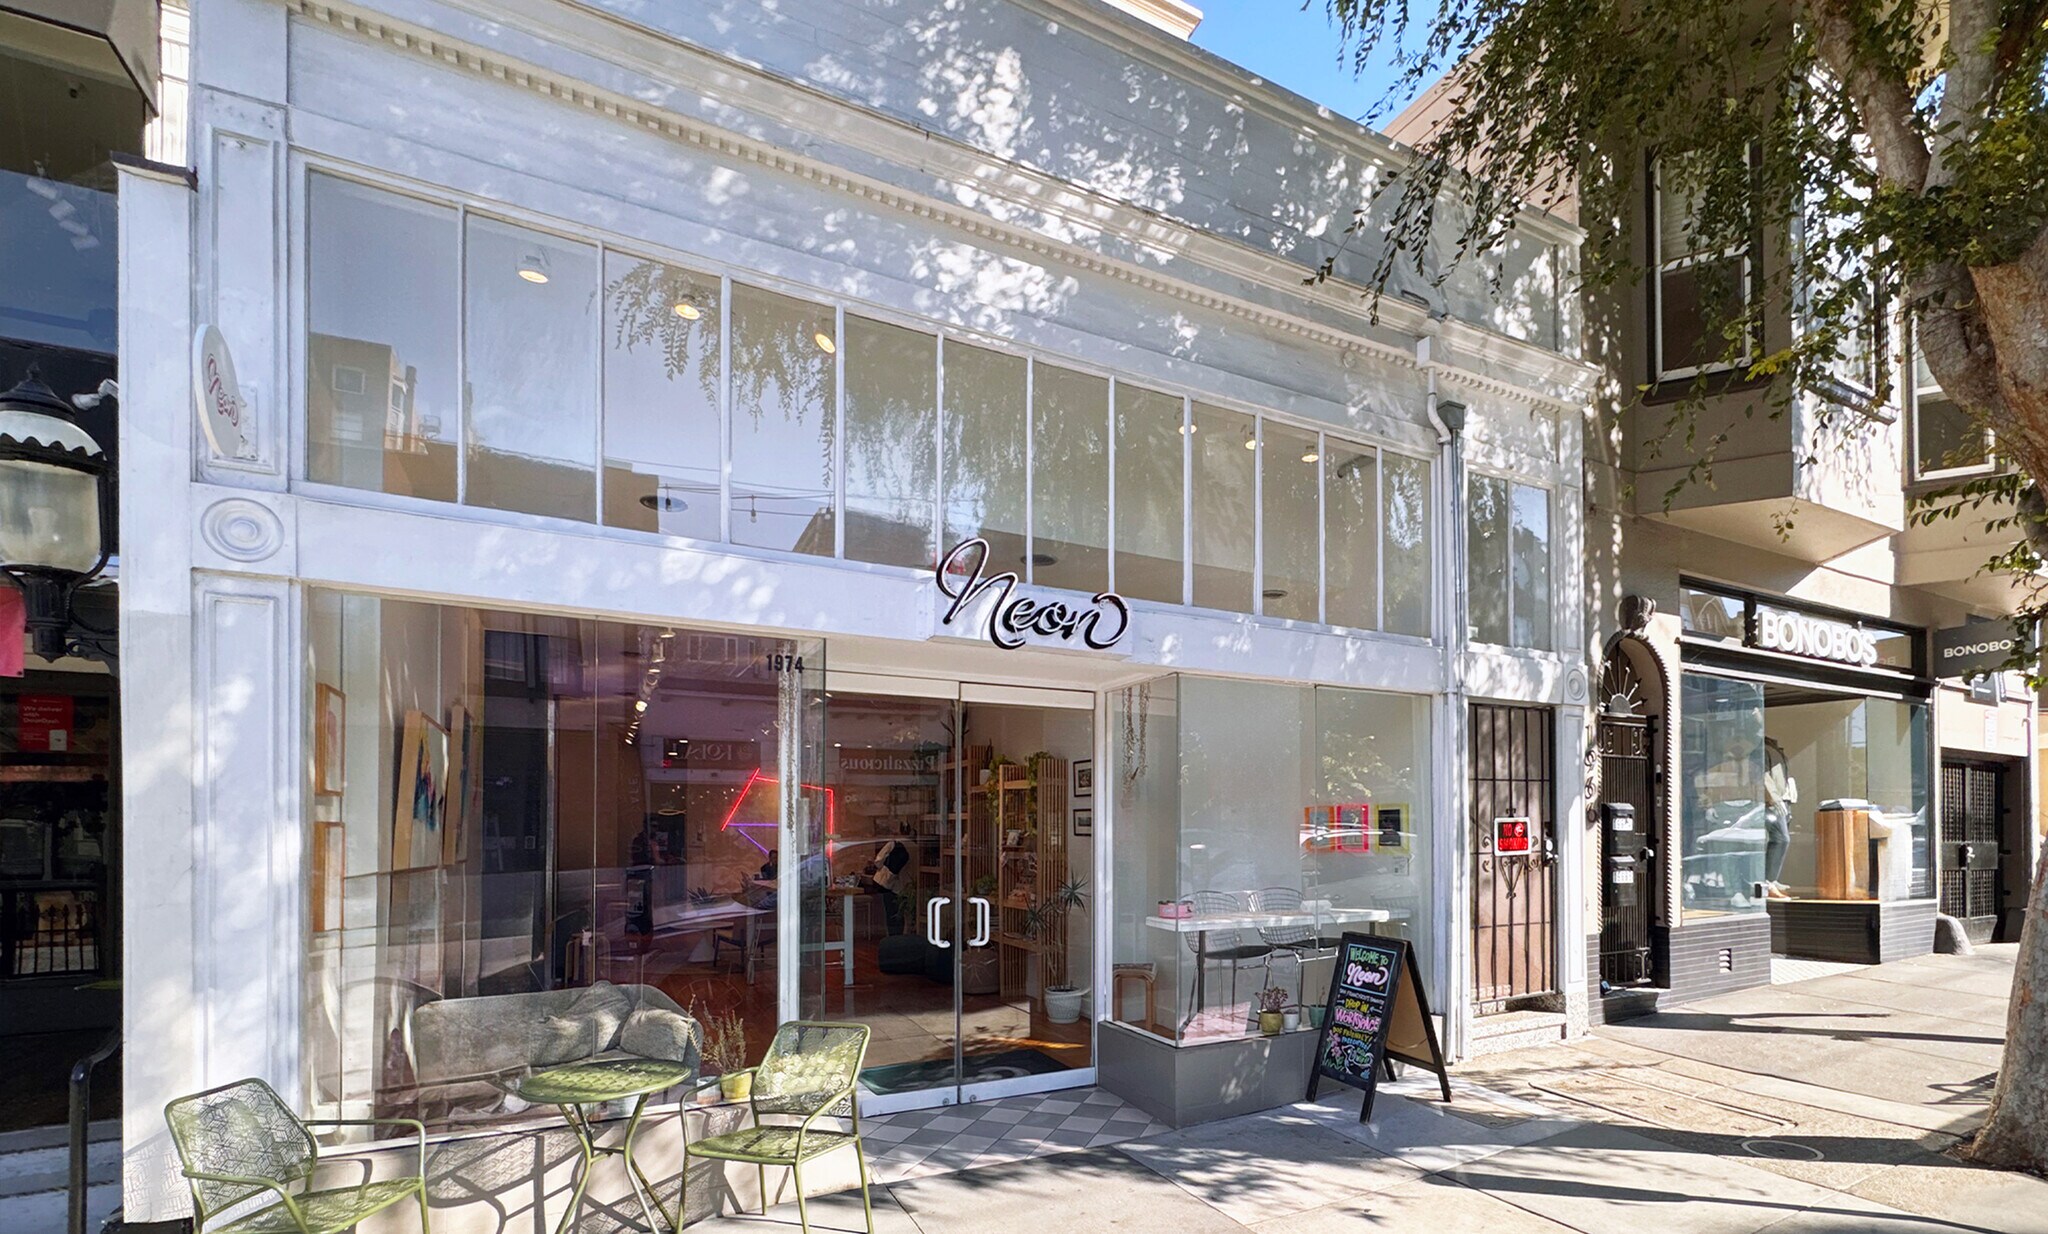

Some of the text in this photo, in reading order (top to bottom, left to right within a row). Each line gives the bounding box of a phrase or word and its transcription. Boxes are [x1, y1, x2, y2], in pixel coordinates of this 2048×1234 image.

[936, 537, 1131, 650] Neon
[1760, 610, 1878, 665] BONOBOS
[1943, 639, 2015, 658] BONOBO
[766, 653, 805, 674] 1974
[1503, 823, 1513, 837] NO
[1498, 837, 1528, 850] SMOKING
[1350, 947, 1389, 966] WELCOME TO
[1347, 963, 1389, 986] Neon
[1335, 1008, 1381, 1032] WORKSPACE
